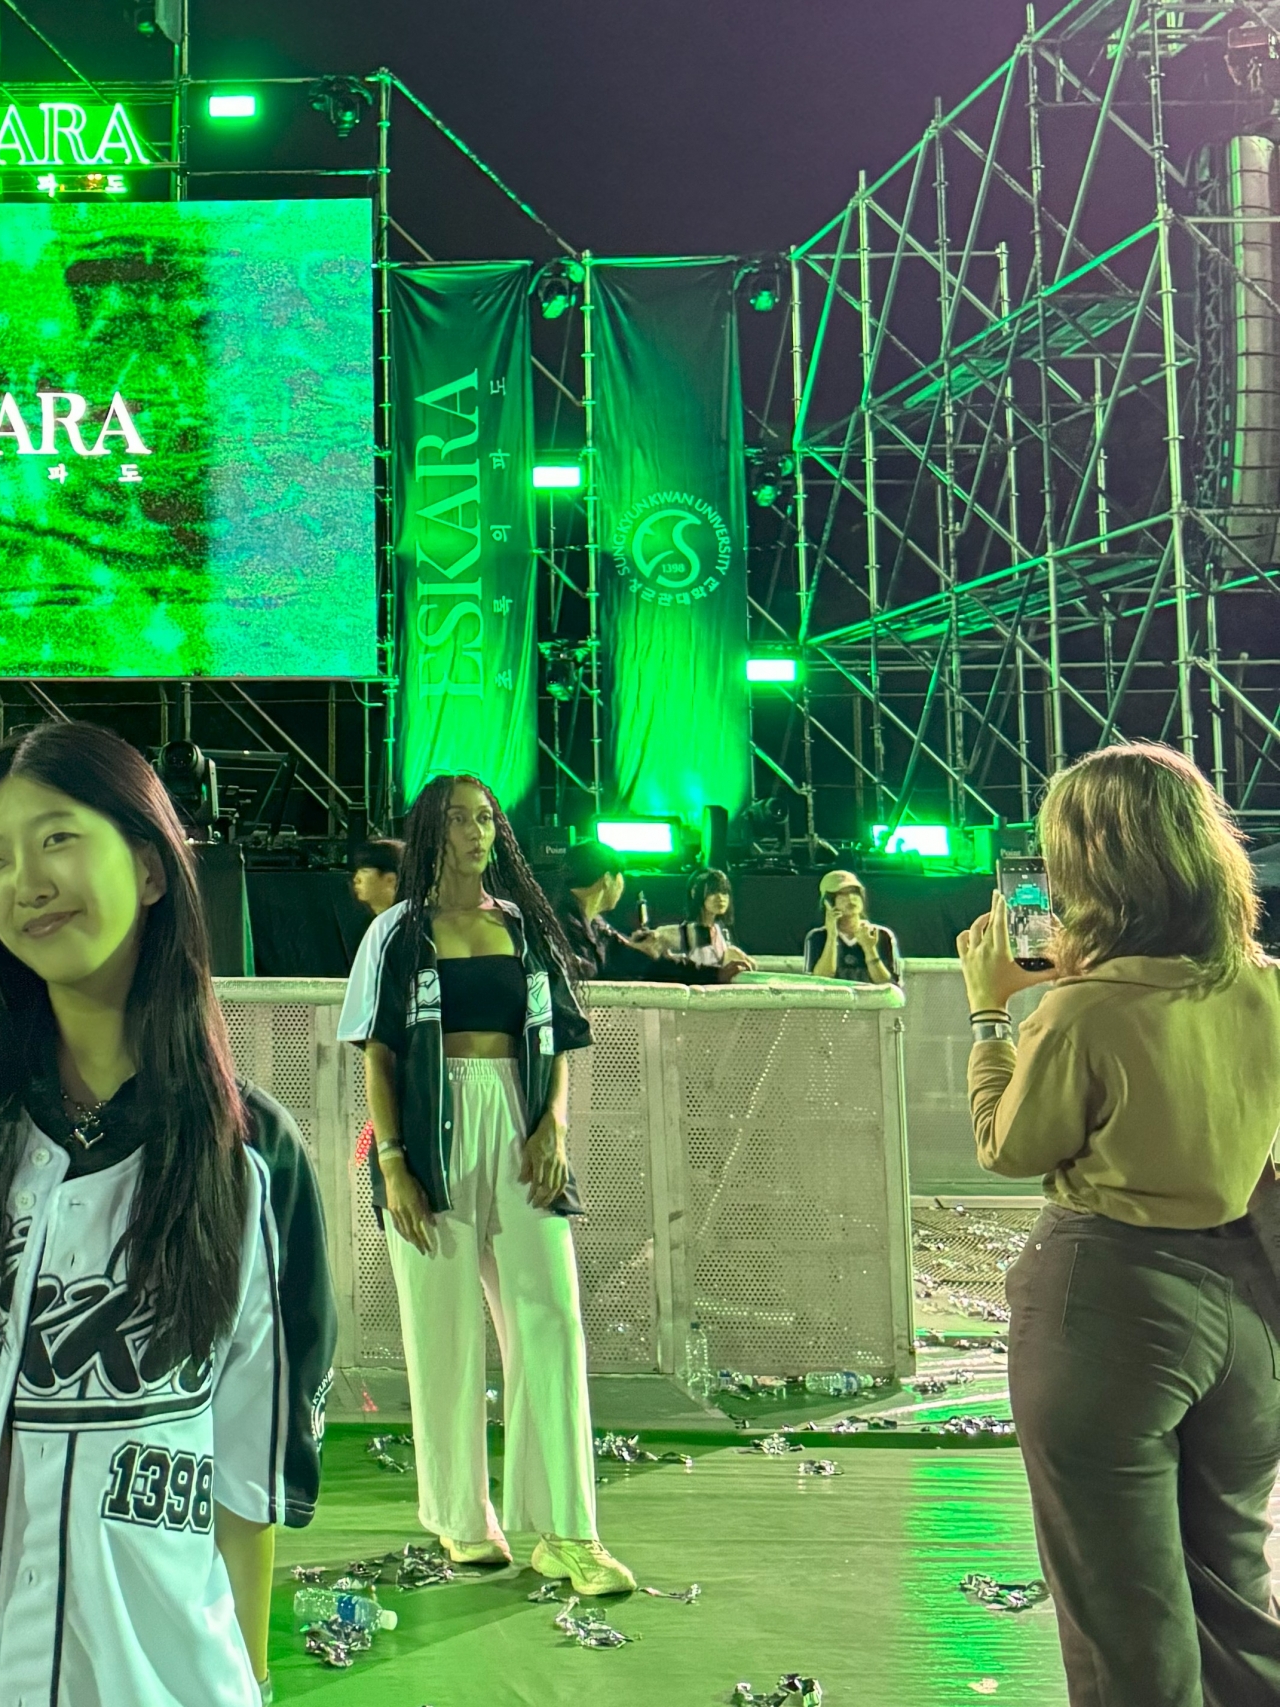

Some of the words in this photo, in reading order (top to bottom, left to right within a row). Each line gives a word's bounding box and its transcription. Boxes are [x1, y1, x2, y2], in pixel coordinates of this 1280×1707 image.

[414, 368, 484, 701] ESKARA
[612, 490, 695, 576] SUNGKYUNKWAN
[694, 498, 732, 576] UNIVERSITY
[101, 1440, 214, 1535] 1398
